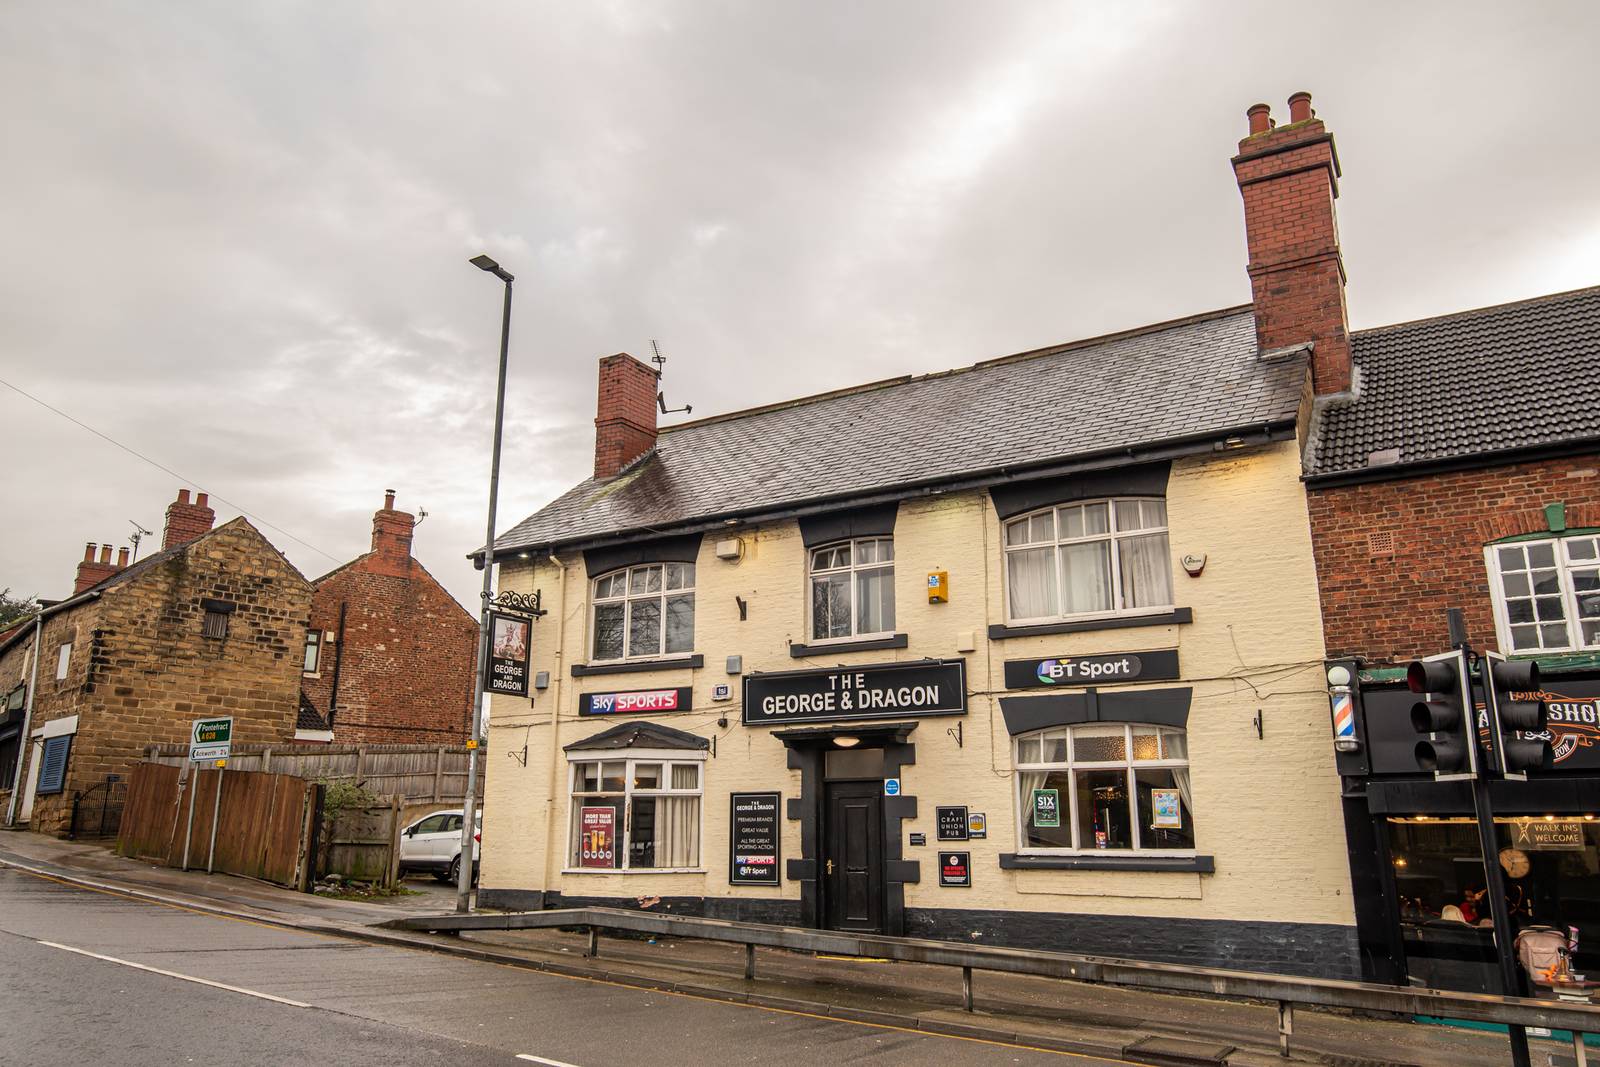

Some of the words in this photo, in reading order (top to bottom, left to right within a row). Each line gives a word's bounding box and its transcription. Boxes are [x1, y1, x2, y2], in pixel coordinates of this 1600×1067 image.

[494, 664, 522, 676] GEORGE
[1049, 663, 1077, 678] BT
[1079, 658, 1130, 679] Sport
[493, 679, 522, 690] DRAGON
[828, 673, 866, 691] THE
[592, 695, 614, 712] sky
[617, 691, 675, 709] SPORTS
[762, 691, 837, 715] GEORGE
[840, 690, 854, 710] &
[858, 685, 939, 709] DRAGON
[202, 723, 228, 731] Pontefract
[1037, 796, 1055, 806] SIX
[1534, 824, 1561, 832] WALK
[1562, 824, 1579, 832] INS
[1534, 834, 1579, 842] WELCOME
[747, 855, 774, 864] SPORTS
[752, 867, 767, 876] Sport
